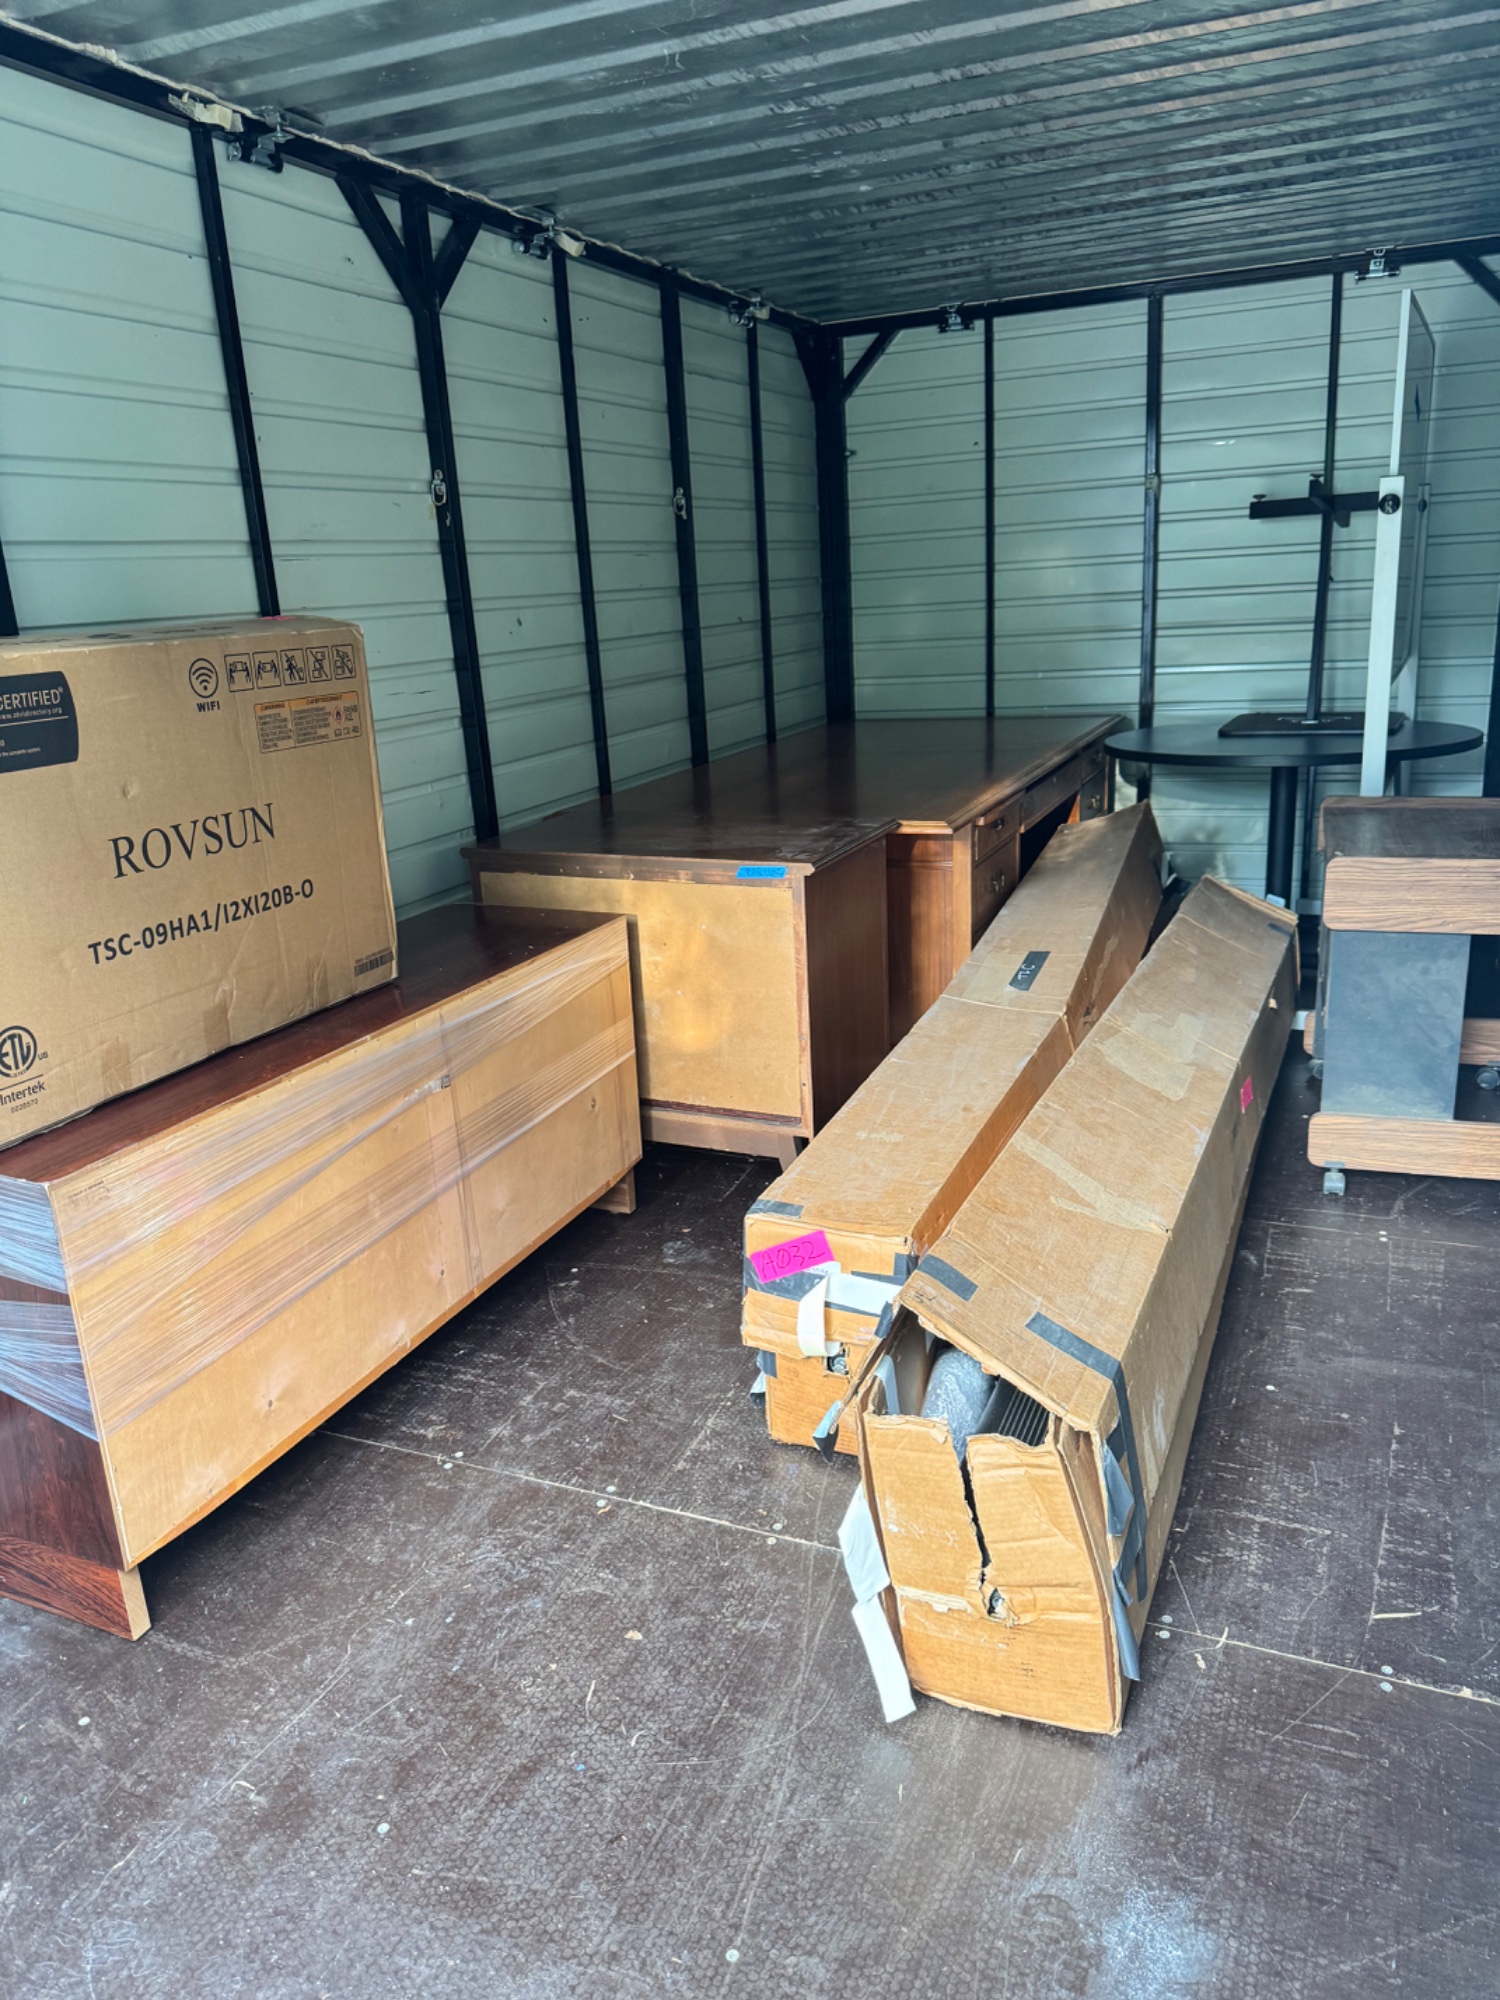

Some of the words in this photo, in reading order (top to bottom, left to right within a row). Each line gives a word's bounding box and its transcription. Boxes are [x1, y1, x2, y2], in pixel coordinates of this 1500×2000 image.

[196, 700, 221, 713] WIFI
[108, 802, 276, 880] ROVSUN
[0, 1080, 46, 1107] Intertek
